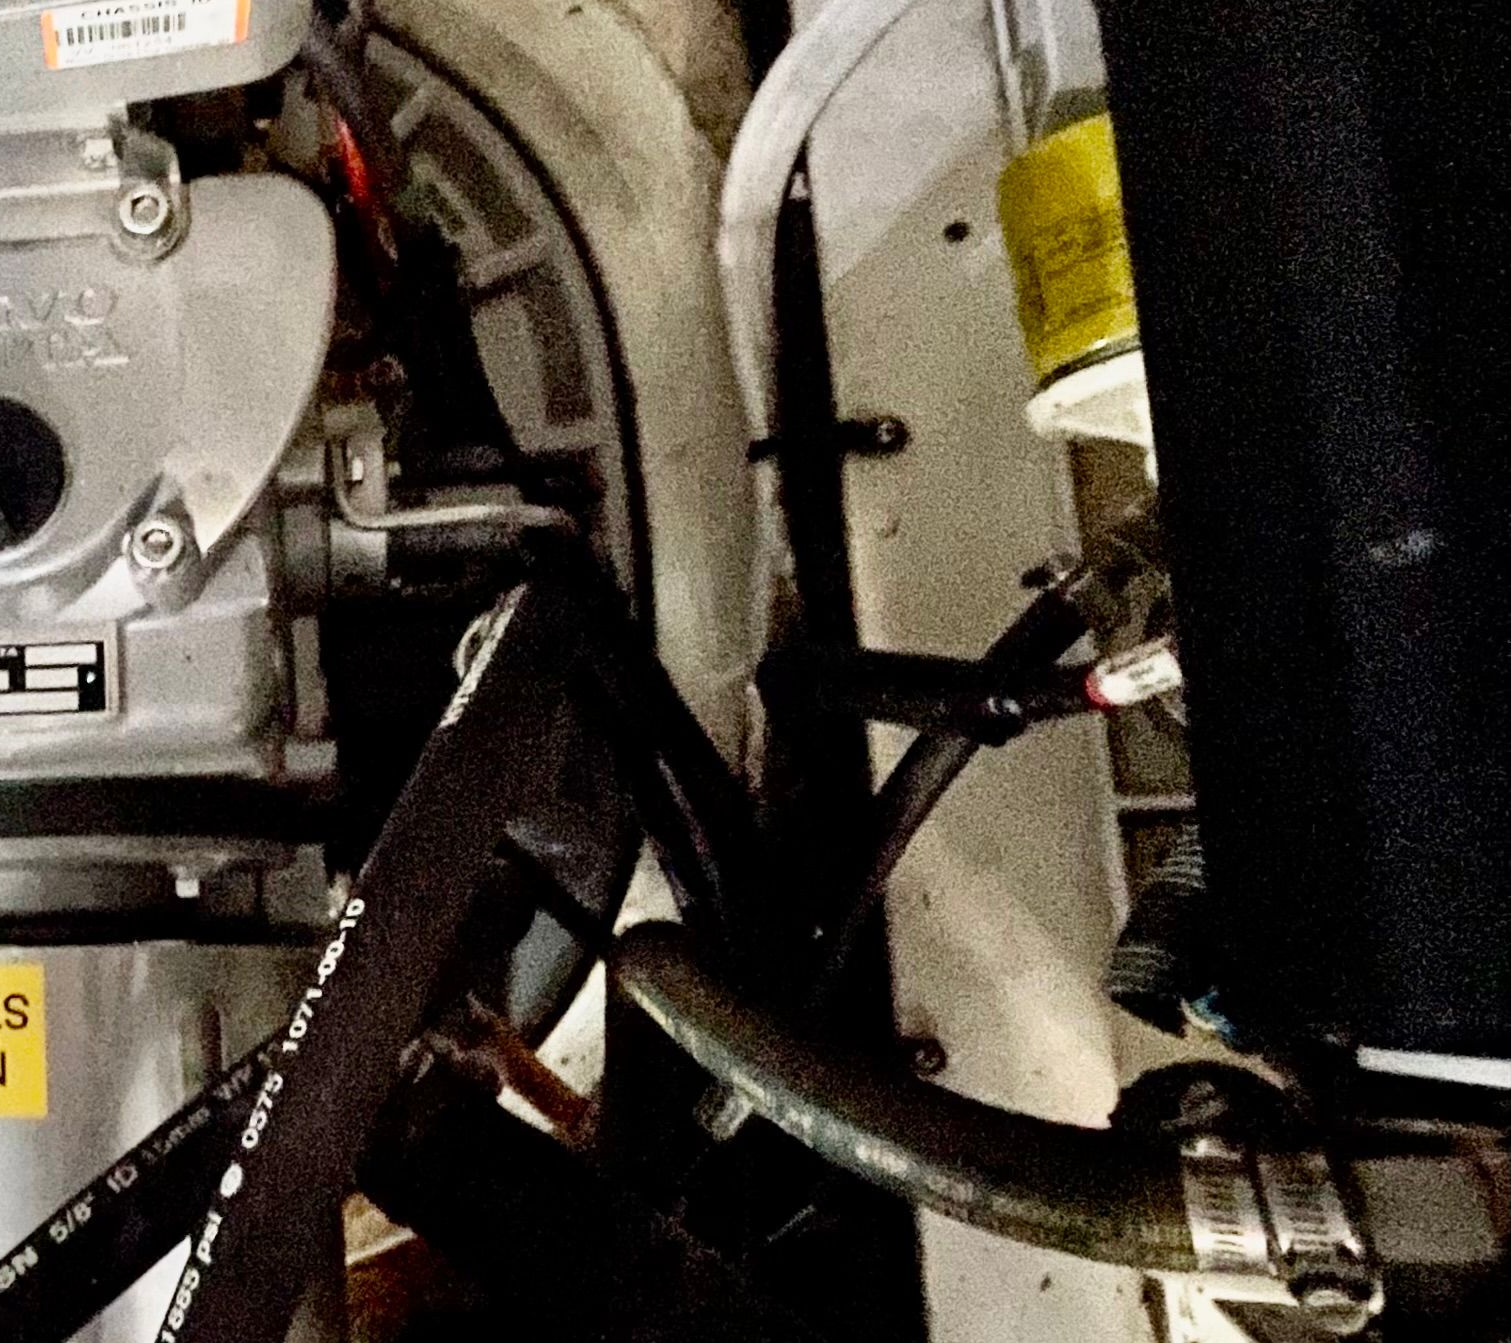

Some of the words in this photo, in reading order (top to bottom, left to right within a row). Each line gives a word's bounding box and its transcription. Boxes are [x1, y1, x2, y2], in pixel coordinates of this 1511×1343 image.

[81, 0, 177, 20] CHASSIS
[196, 1210, 223, 1266] psi
[242, 1071, 284, 1150] 0575
[282, 897, 365, 1053] 1071-00-10
